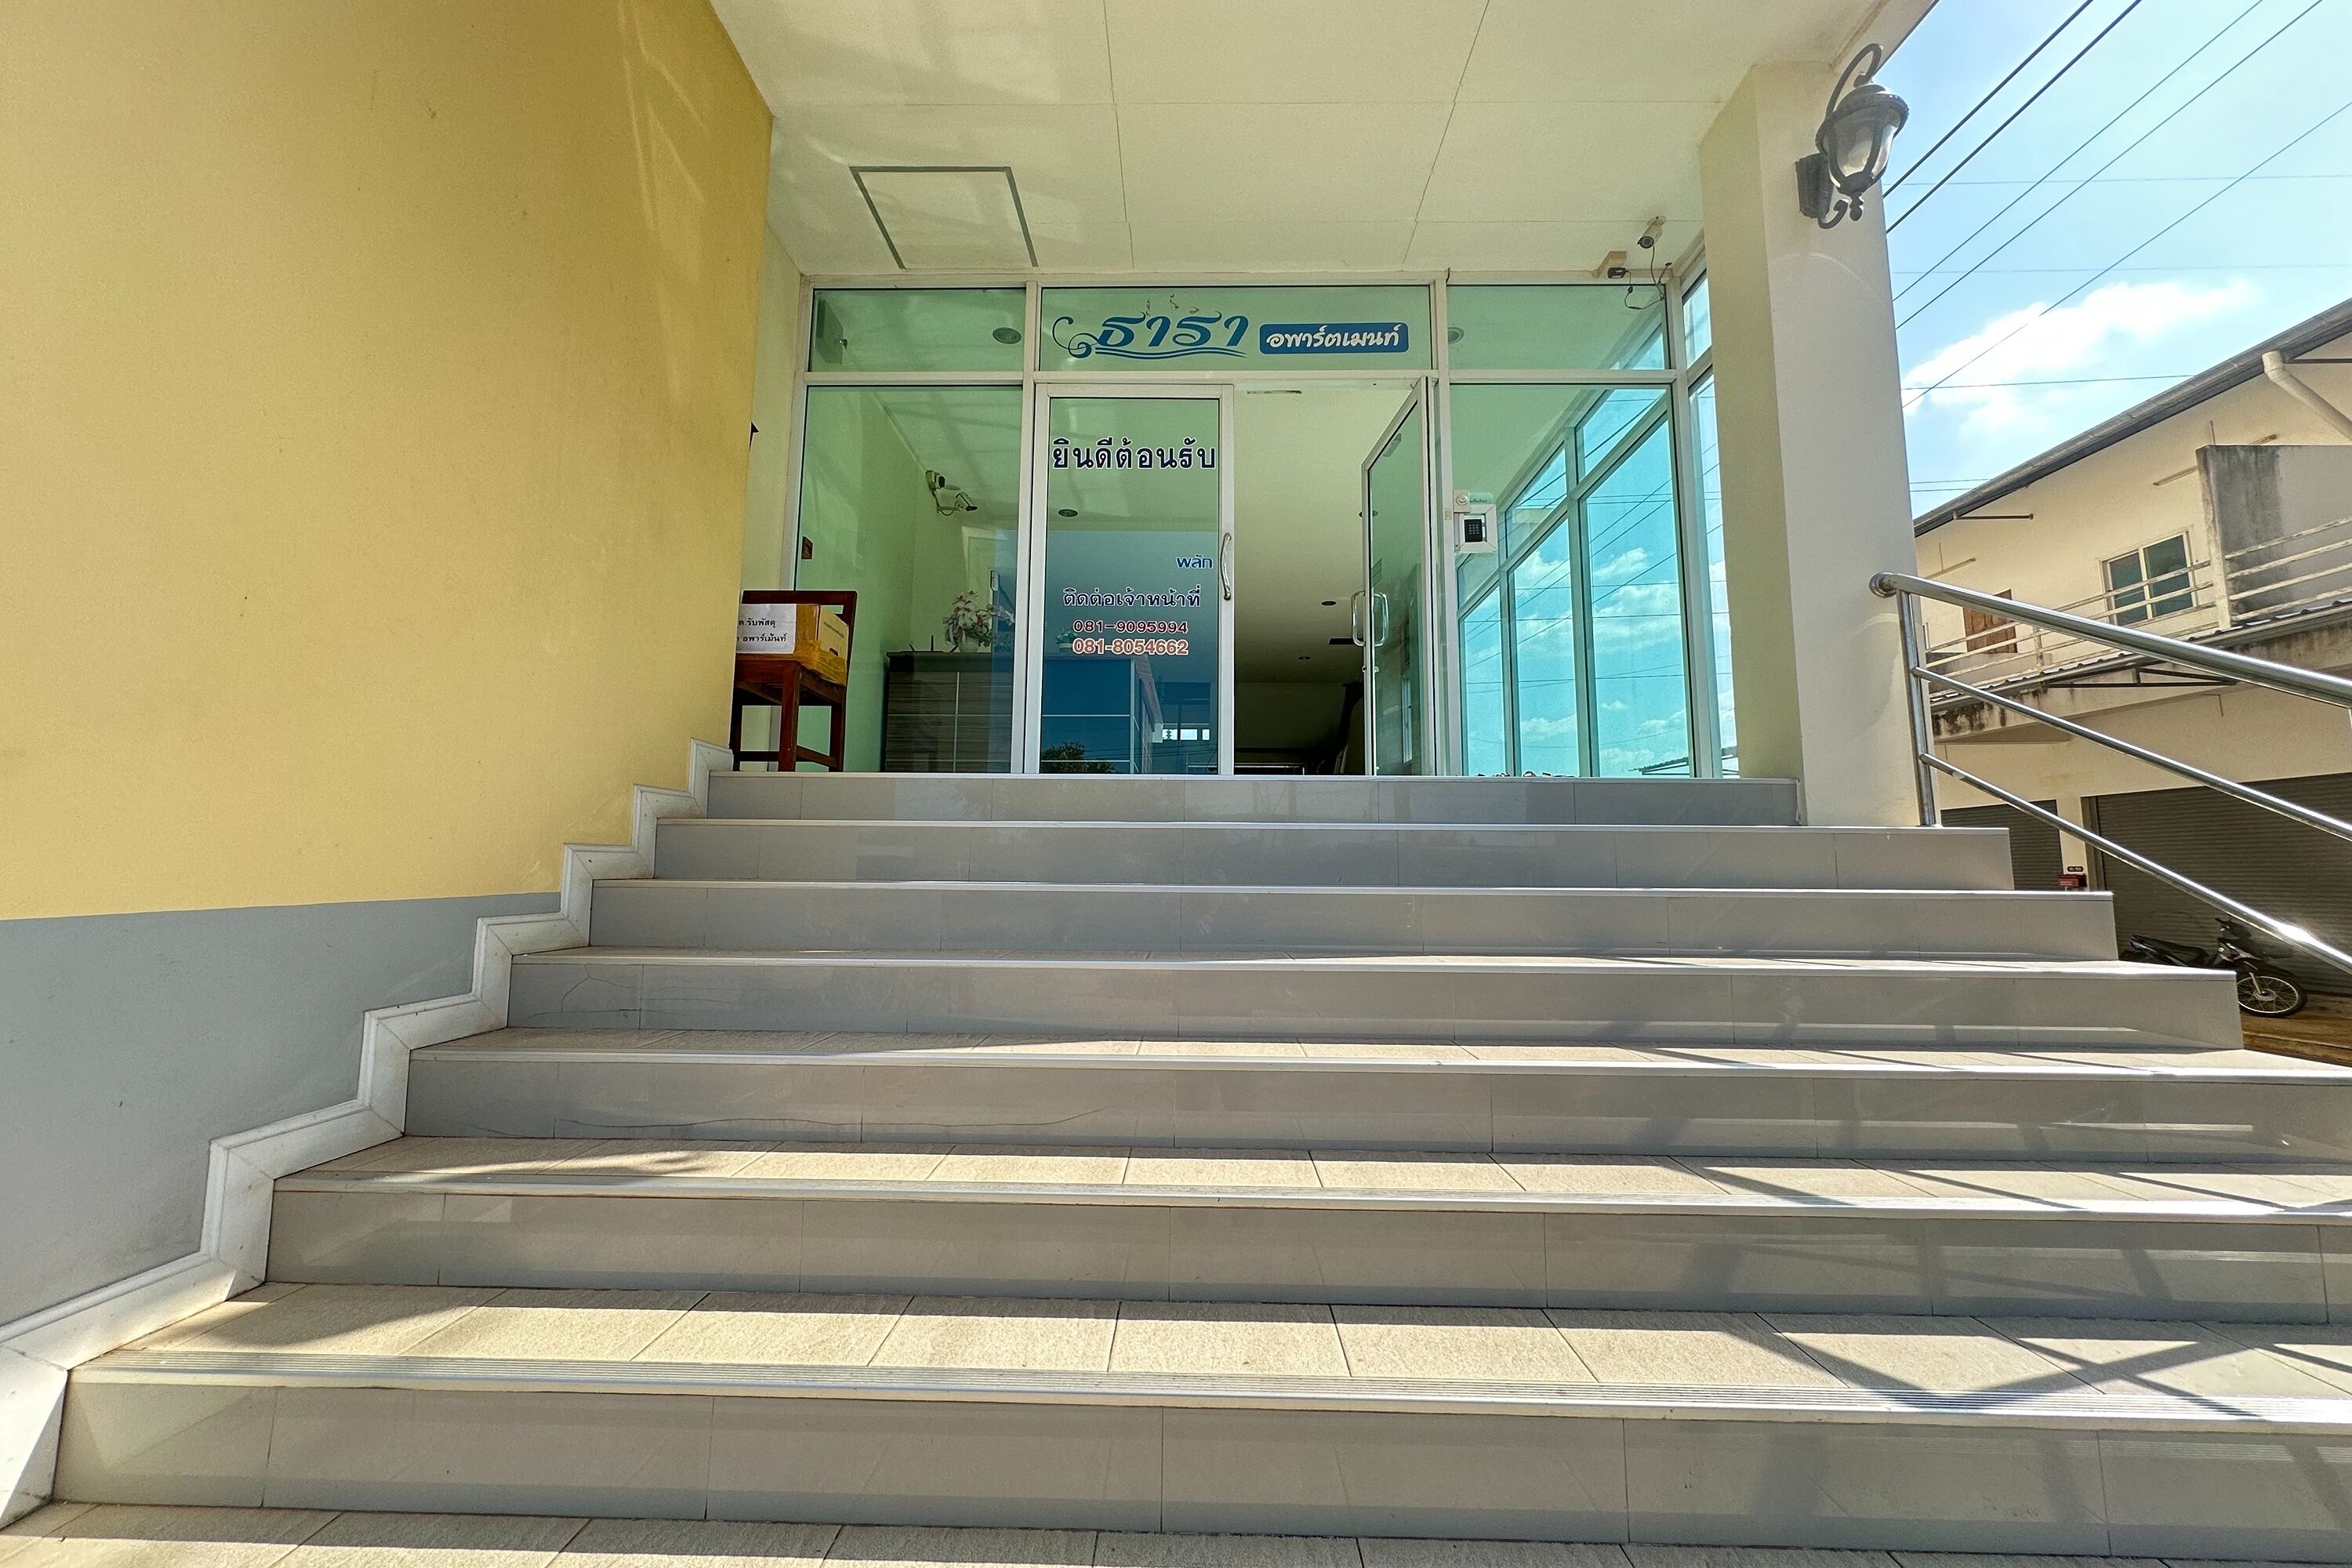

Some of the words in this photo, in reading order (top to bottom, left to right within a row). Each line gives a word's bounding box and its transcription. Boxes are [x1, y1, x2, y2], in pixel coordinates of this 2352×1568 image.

[1093, 310, 1249, 348] ธารา
[1266, 324, 1402, 347] อพาร์ตเมนท์
[1051, 437, 1216, 469] ยินดีต้อนรับ
[1063, 585, 1201, 607] ติดต่อเจ้าหน้าที่
[1073, 620, 1189, 634] 081-9095994
[1073, 638, 1189, 656] 081-8054662
